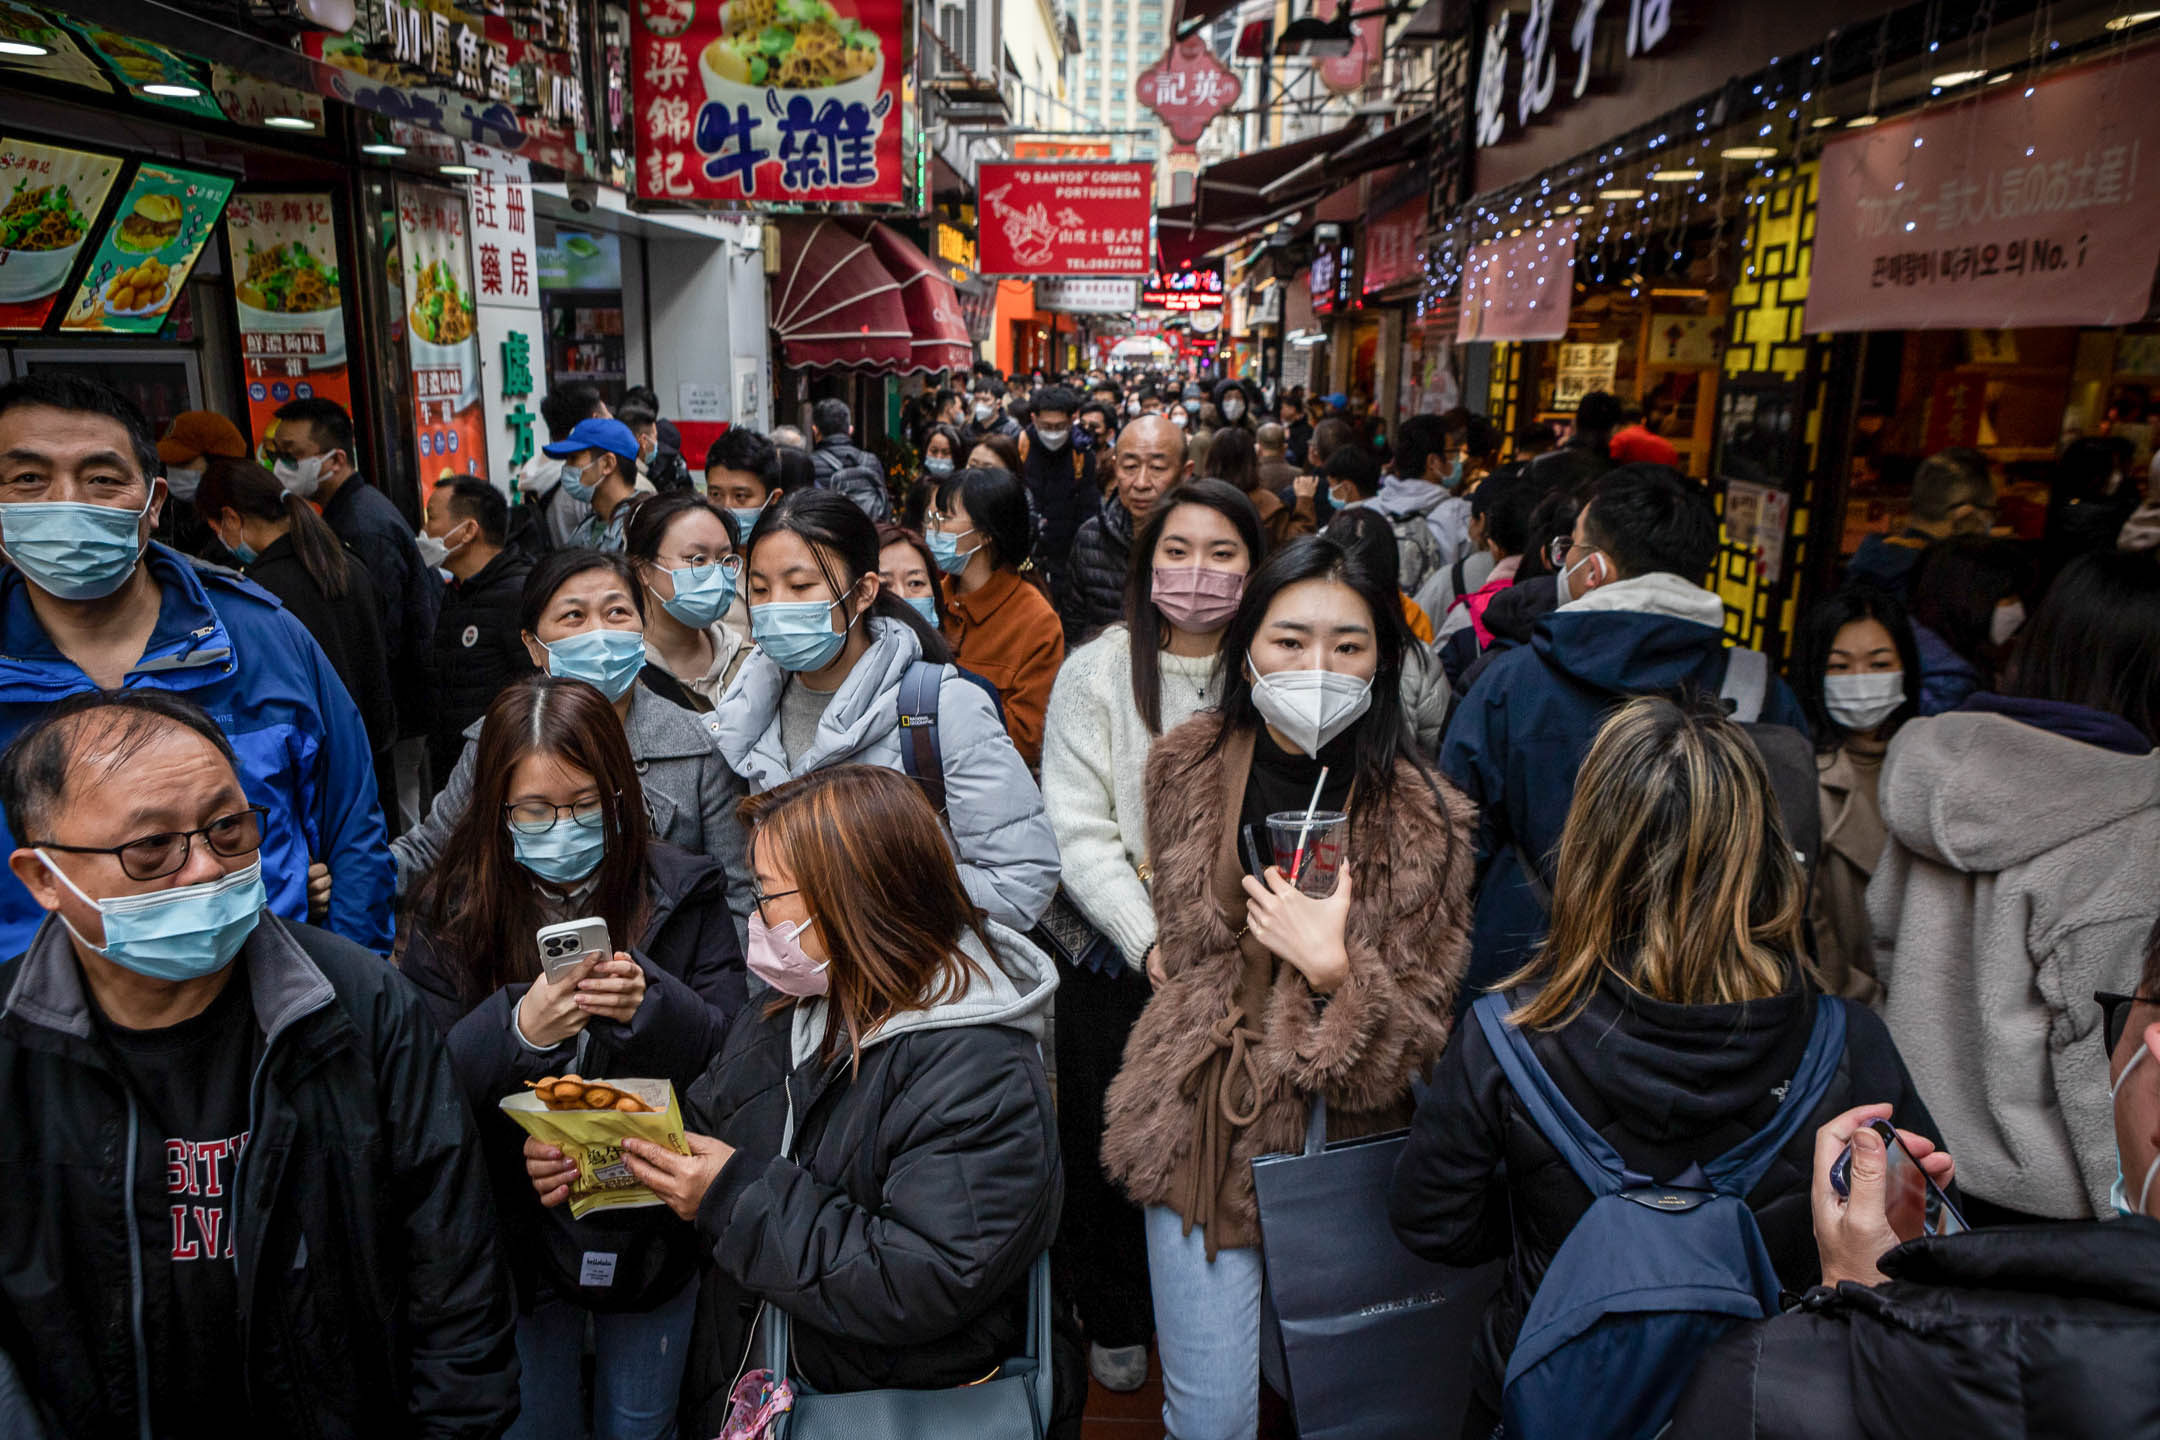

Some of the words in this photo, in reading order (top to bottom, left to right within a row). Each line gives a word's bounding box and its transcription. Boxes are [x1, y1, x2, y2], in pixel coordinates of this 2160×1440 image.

[644, 41, 695, 196] 梁錦記
[1091, 171, 1141, 184] COMIDA
[1056, 186, 1141, 199] PORTUGUESA
[1107, 245, 1143, 256] TAIPA
[2031, 239, 2068, 272] No.
[171, 1204, 234, 1260] LV
